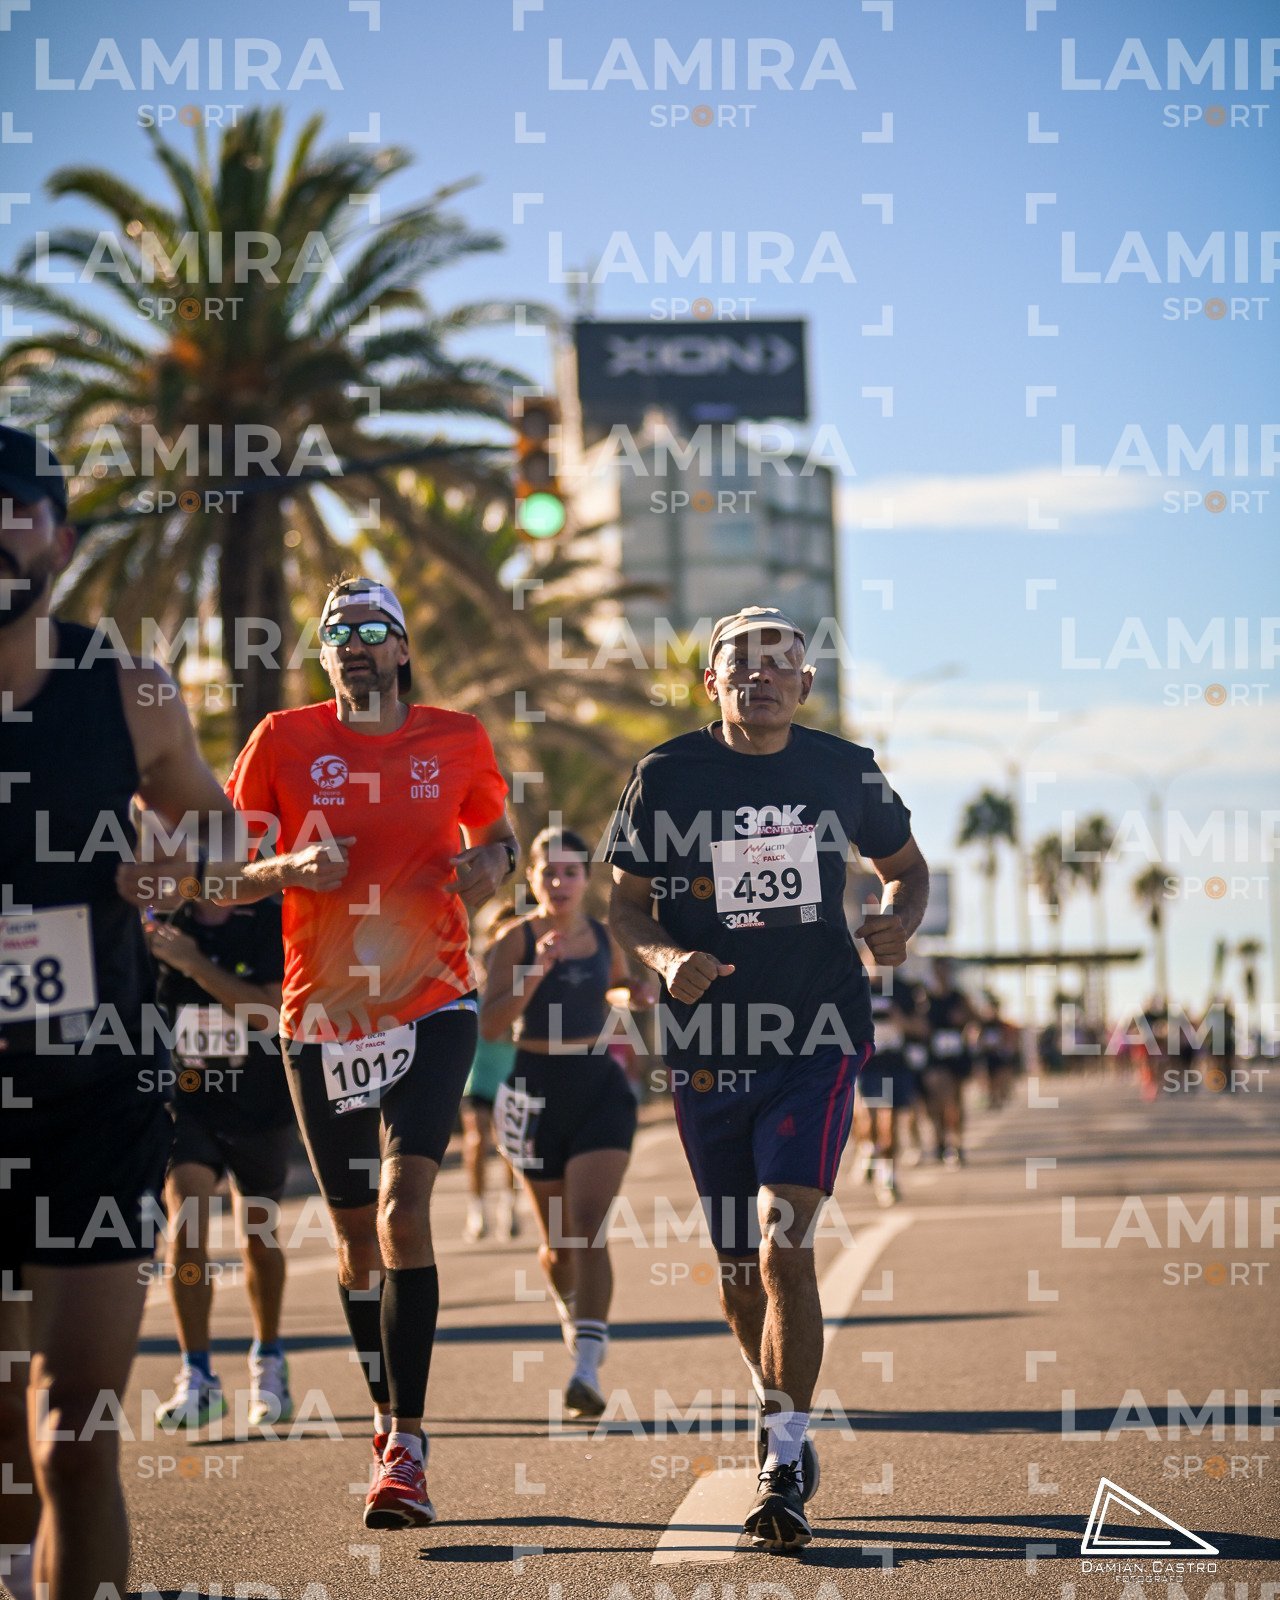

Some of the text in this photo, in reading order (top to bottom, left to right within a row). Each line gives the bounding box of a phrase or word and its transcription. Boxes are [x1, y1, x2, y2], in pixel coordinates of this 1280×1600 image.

[312, 794, 345, 805] koru
[411, 784, 439, 799] OTSO
[734, 804, 807, 836] 30K
[765, 843, 785, 851] ucm
[734, 867, 802, 904] 439
[725, 912, 761, 929] 30K
[331, 1048, 410, 1092] 1012
